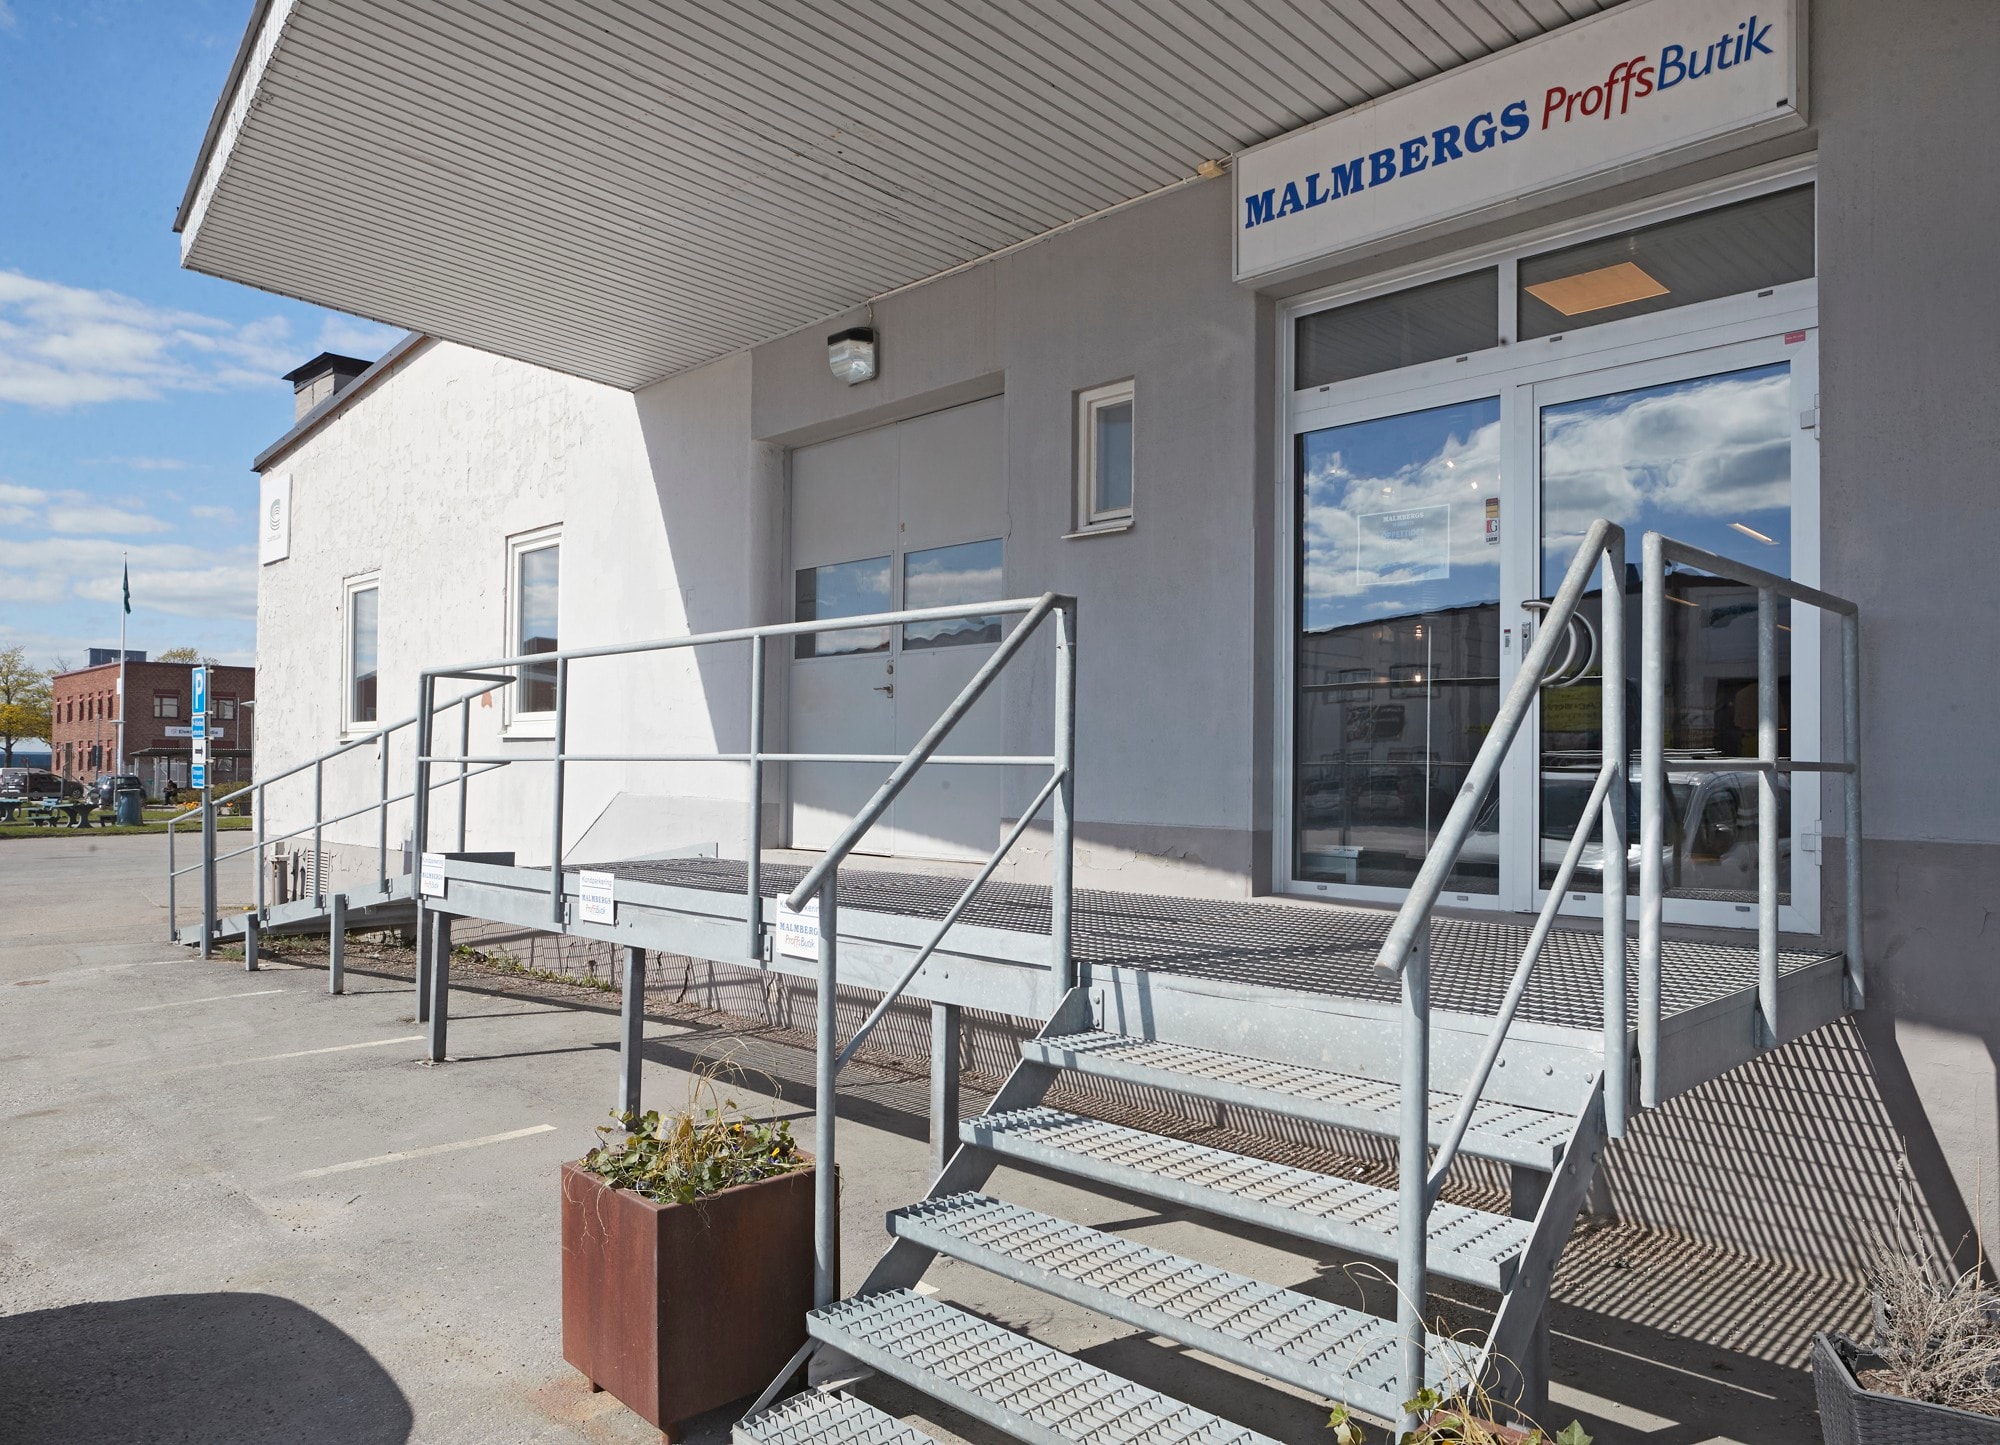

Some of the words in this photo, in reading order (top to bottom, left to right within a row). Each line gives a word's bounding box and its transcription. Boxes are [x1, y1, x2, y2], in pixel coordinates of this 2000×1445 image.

[1245, 100, 1530, 229] MALMBERGS
[1541, 15, 1774, 130] ProffsButik
[195, 672, 204, 709] P
[581, 893, 612, 905] MALMBERGS
[780, 922, 819, 936] MALMBERG
[785, 934, 815, 949] ProffsButik
